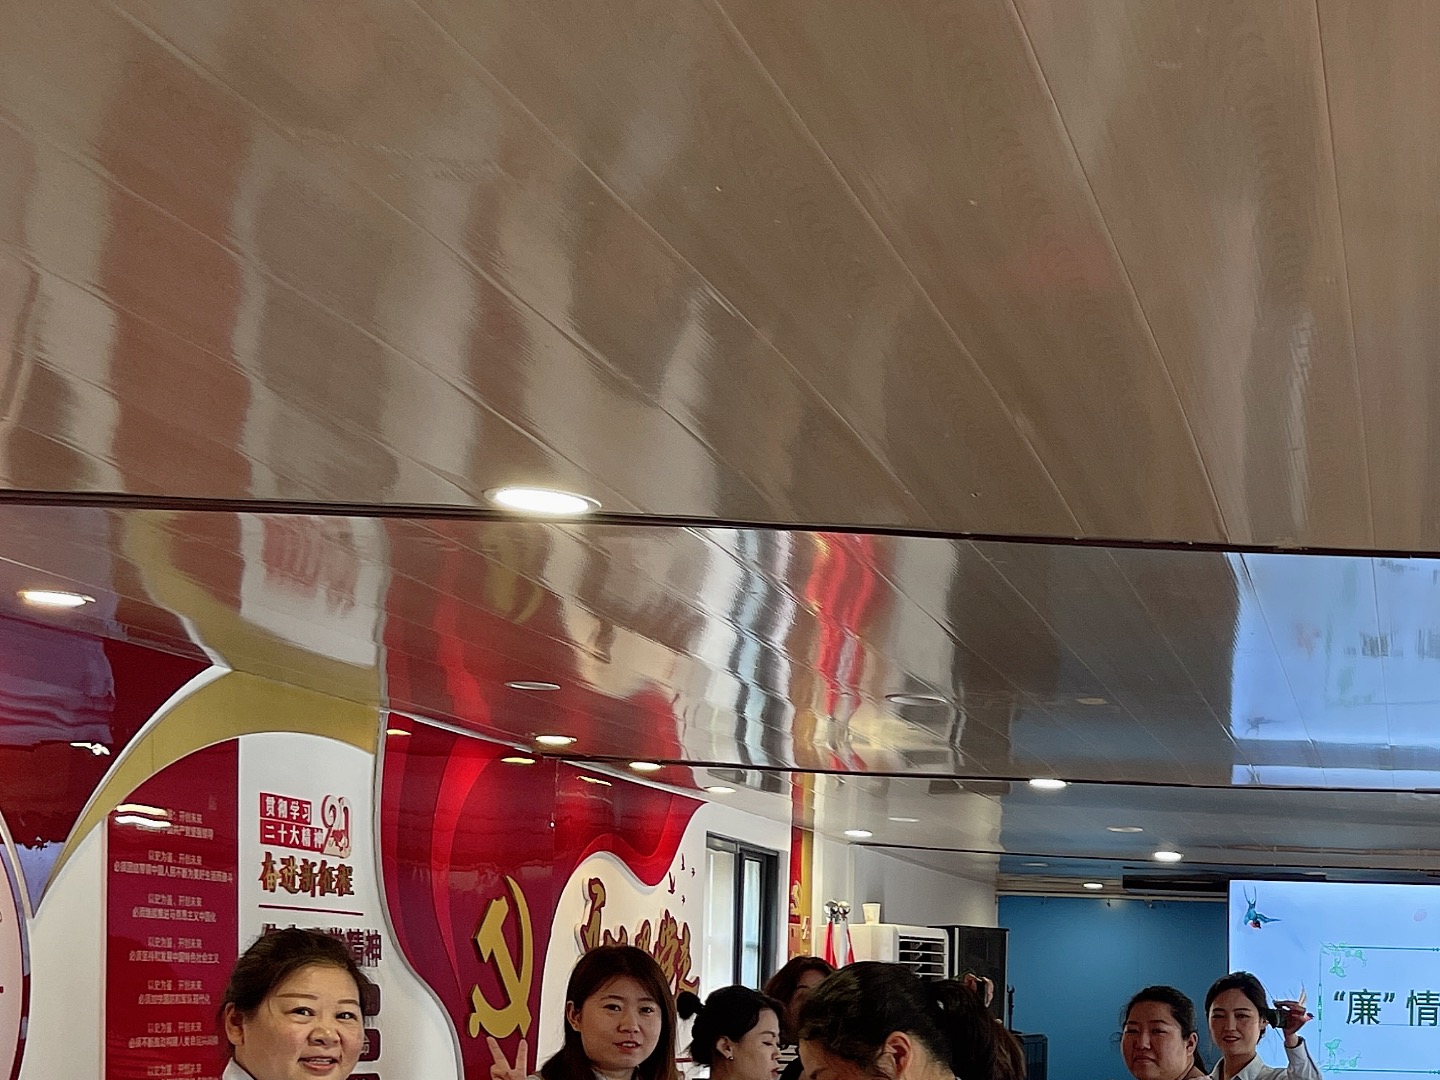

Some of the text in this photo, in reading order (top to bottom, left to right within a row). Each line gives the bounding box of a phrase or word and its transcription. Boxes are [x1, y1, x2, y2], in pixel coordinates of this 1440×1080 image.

[265, 796, 311, 825] 贯彻学习
[264, 824, 325, 849] 二十大精神
[258, 851, 355, 897] 奋进新征程
